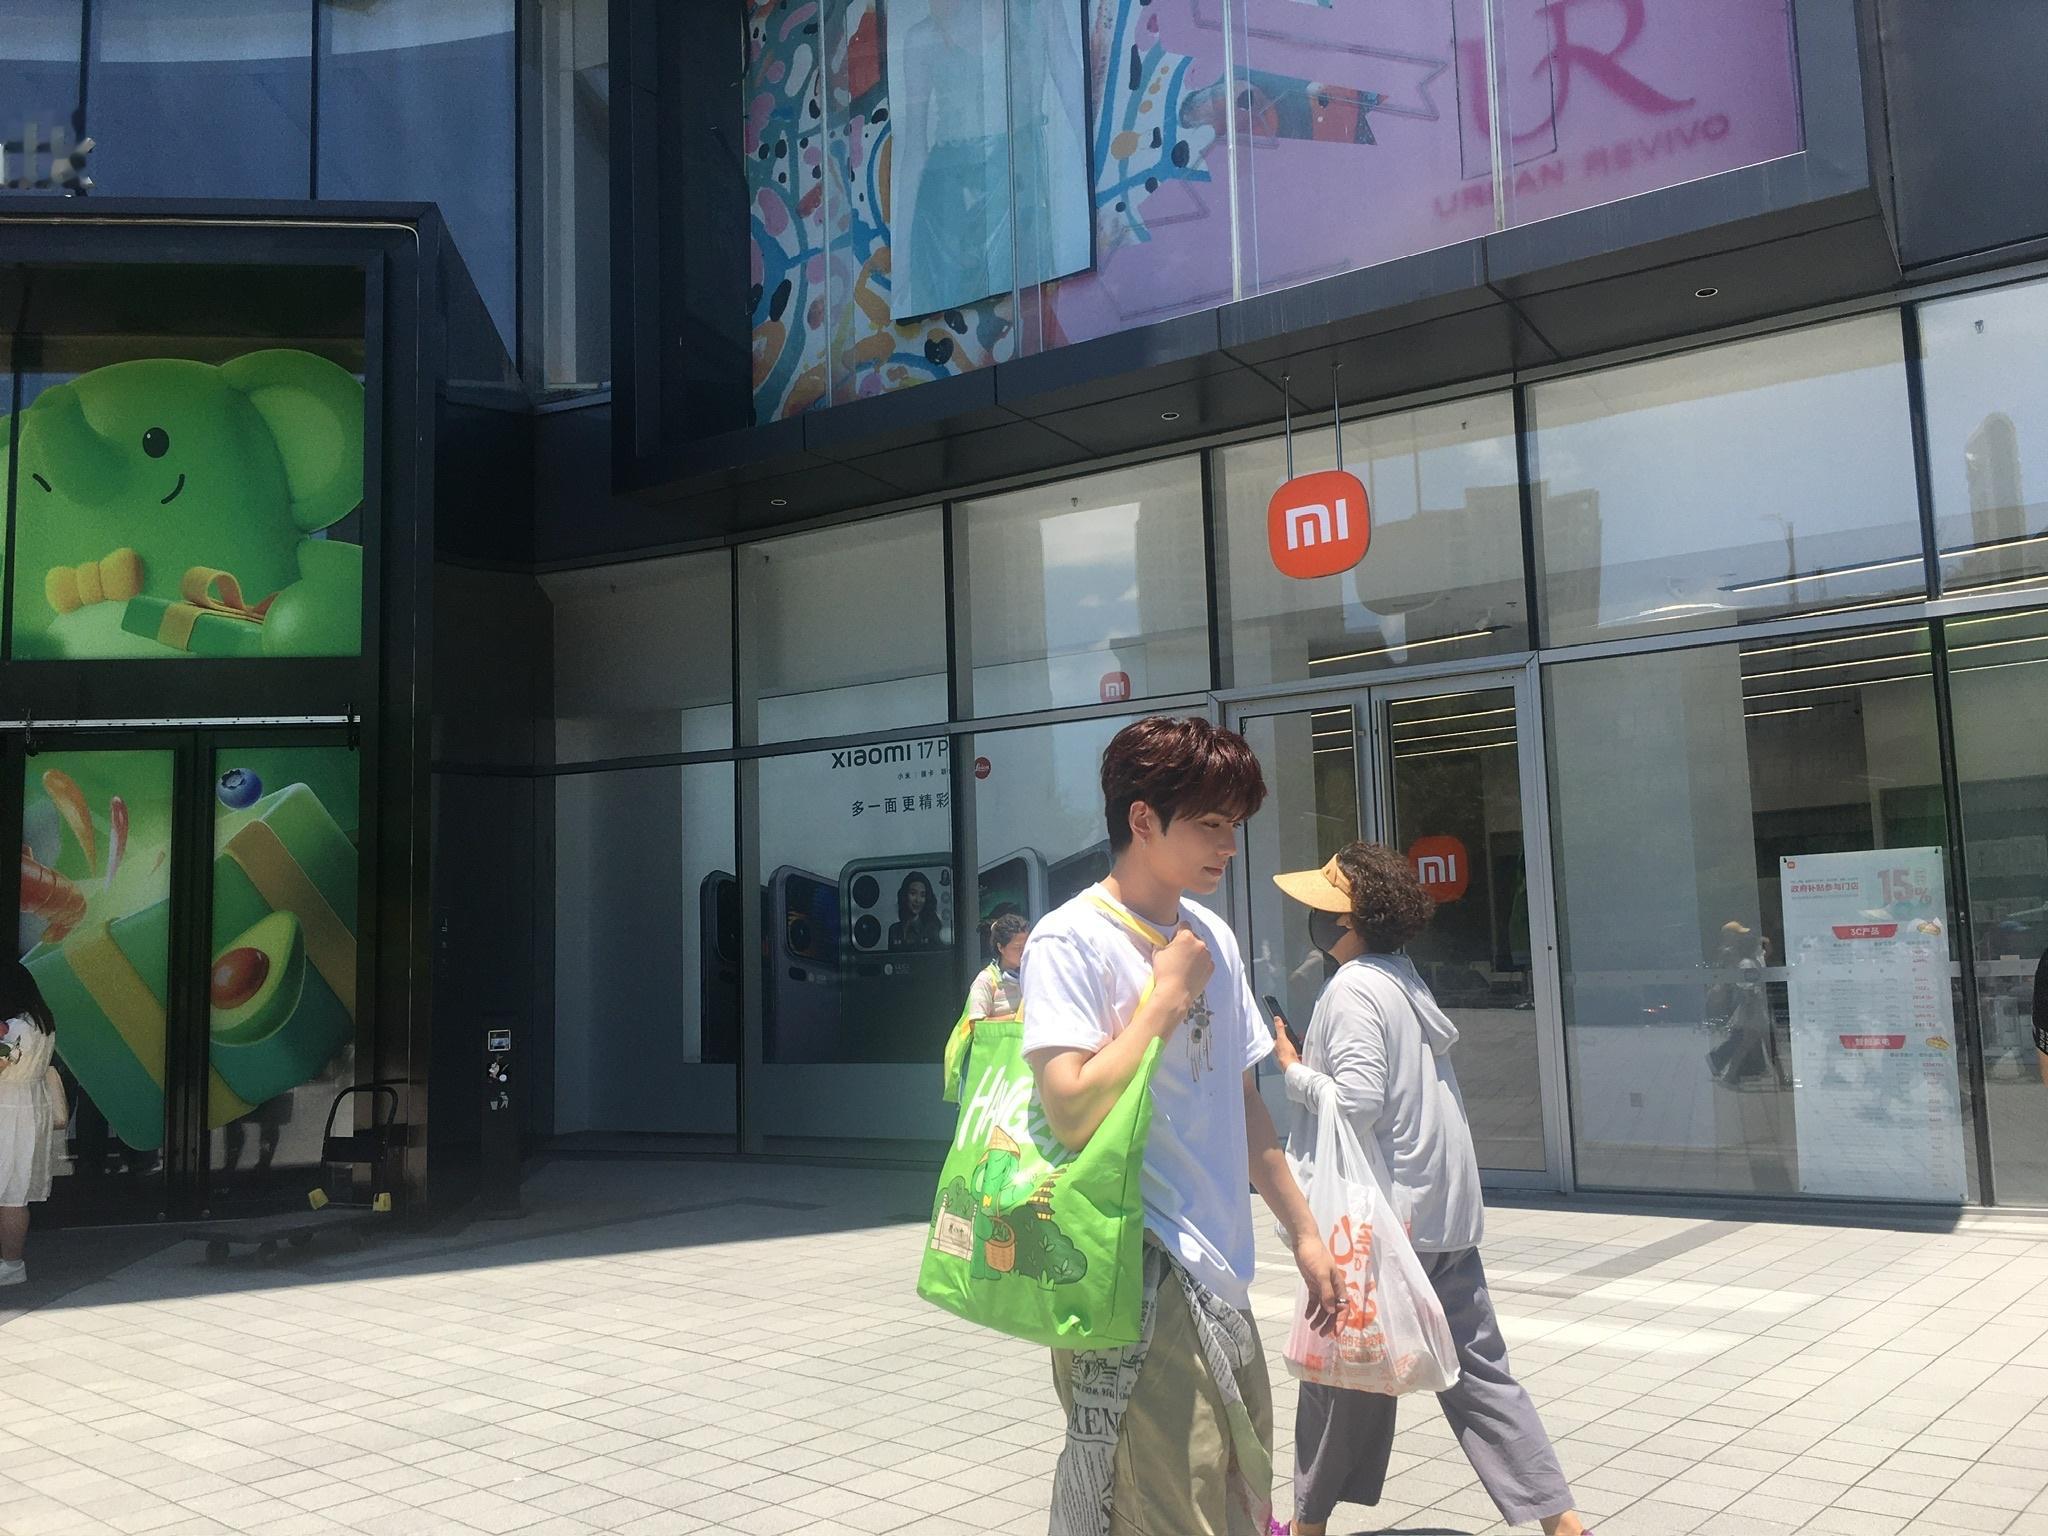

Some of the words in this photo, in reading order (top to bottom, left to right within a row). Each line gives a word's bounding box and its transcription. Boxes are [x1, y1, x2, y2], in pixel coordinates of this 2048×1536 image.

[917, 740, 934, 760] 17
[852, 791, 950, 817] 多一面更精彩
